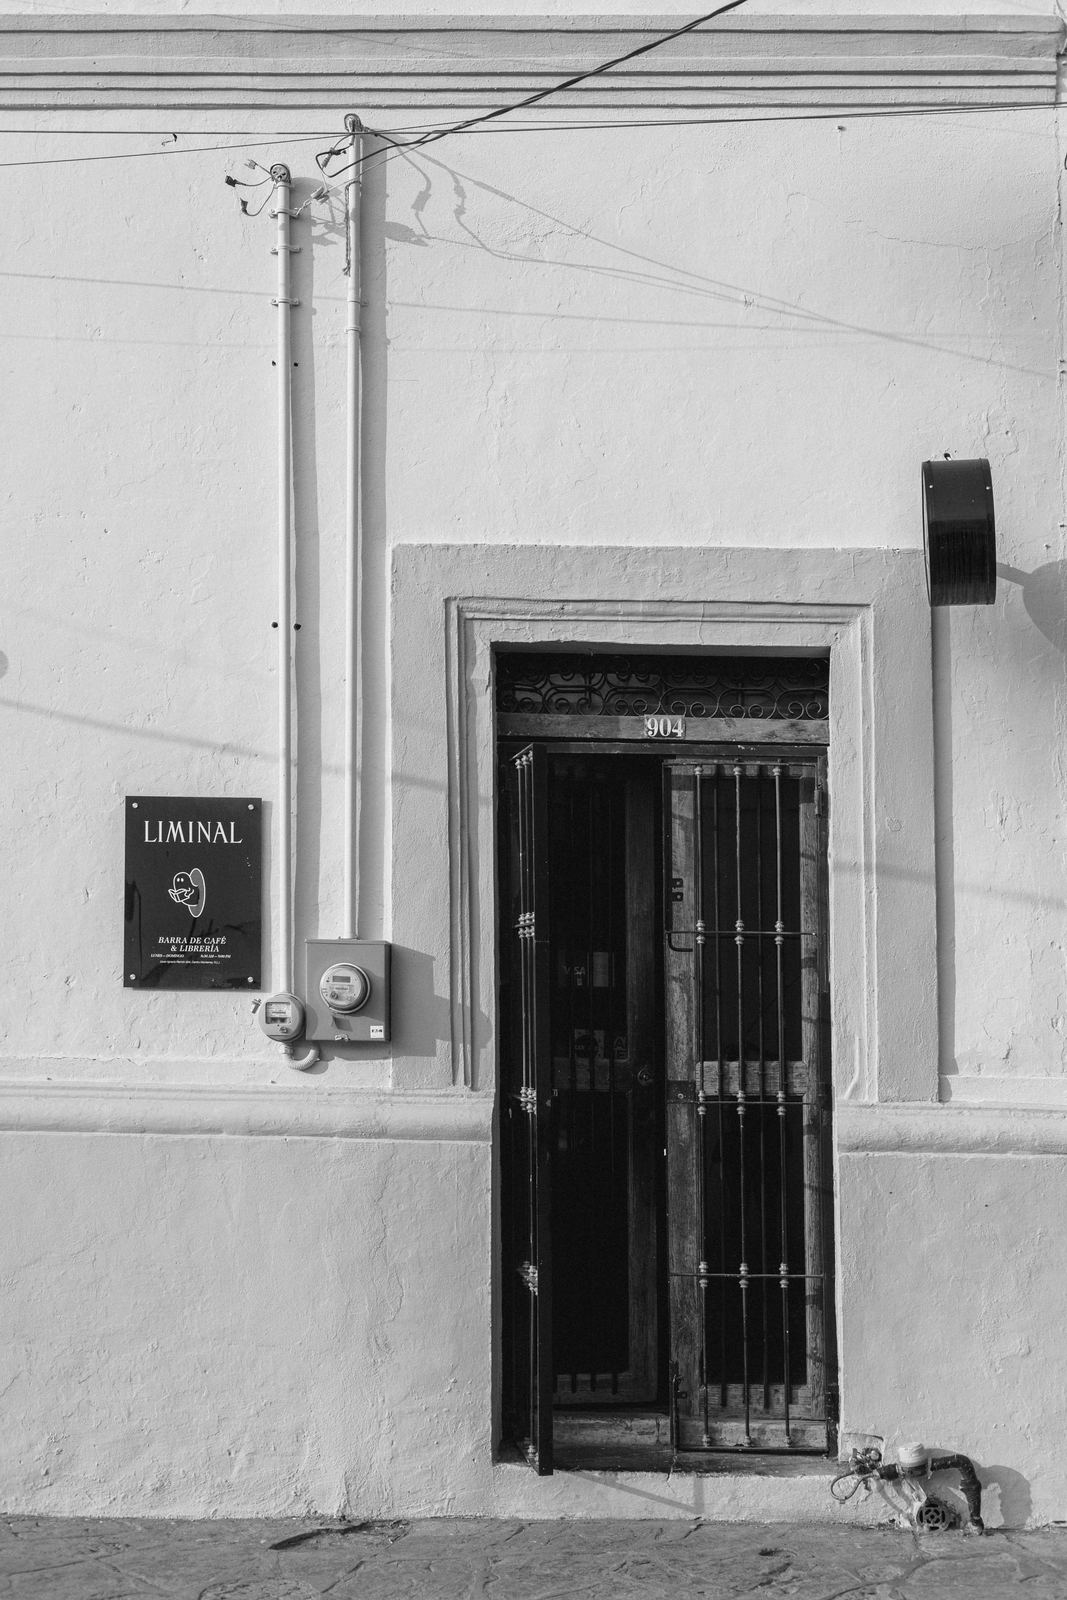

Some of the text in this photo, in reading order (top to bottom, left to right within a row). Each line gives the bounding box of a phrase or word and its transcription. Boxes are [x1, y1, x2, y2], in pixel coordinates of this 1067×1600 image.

[647, 717, 684, 737] 904
[144, 820, 243, 844] LIMINAL
[158, 935, 227, 945] BARRA DE CAFÉ
[170, 943, 220, 953] & LIBRERÍA
